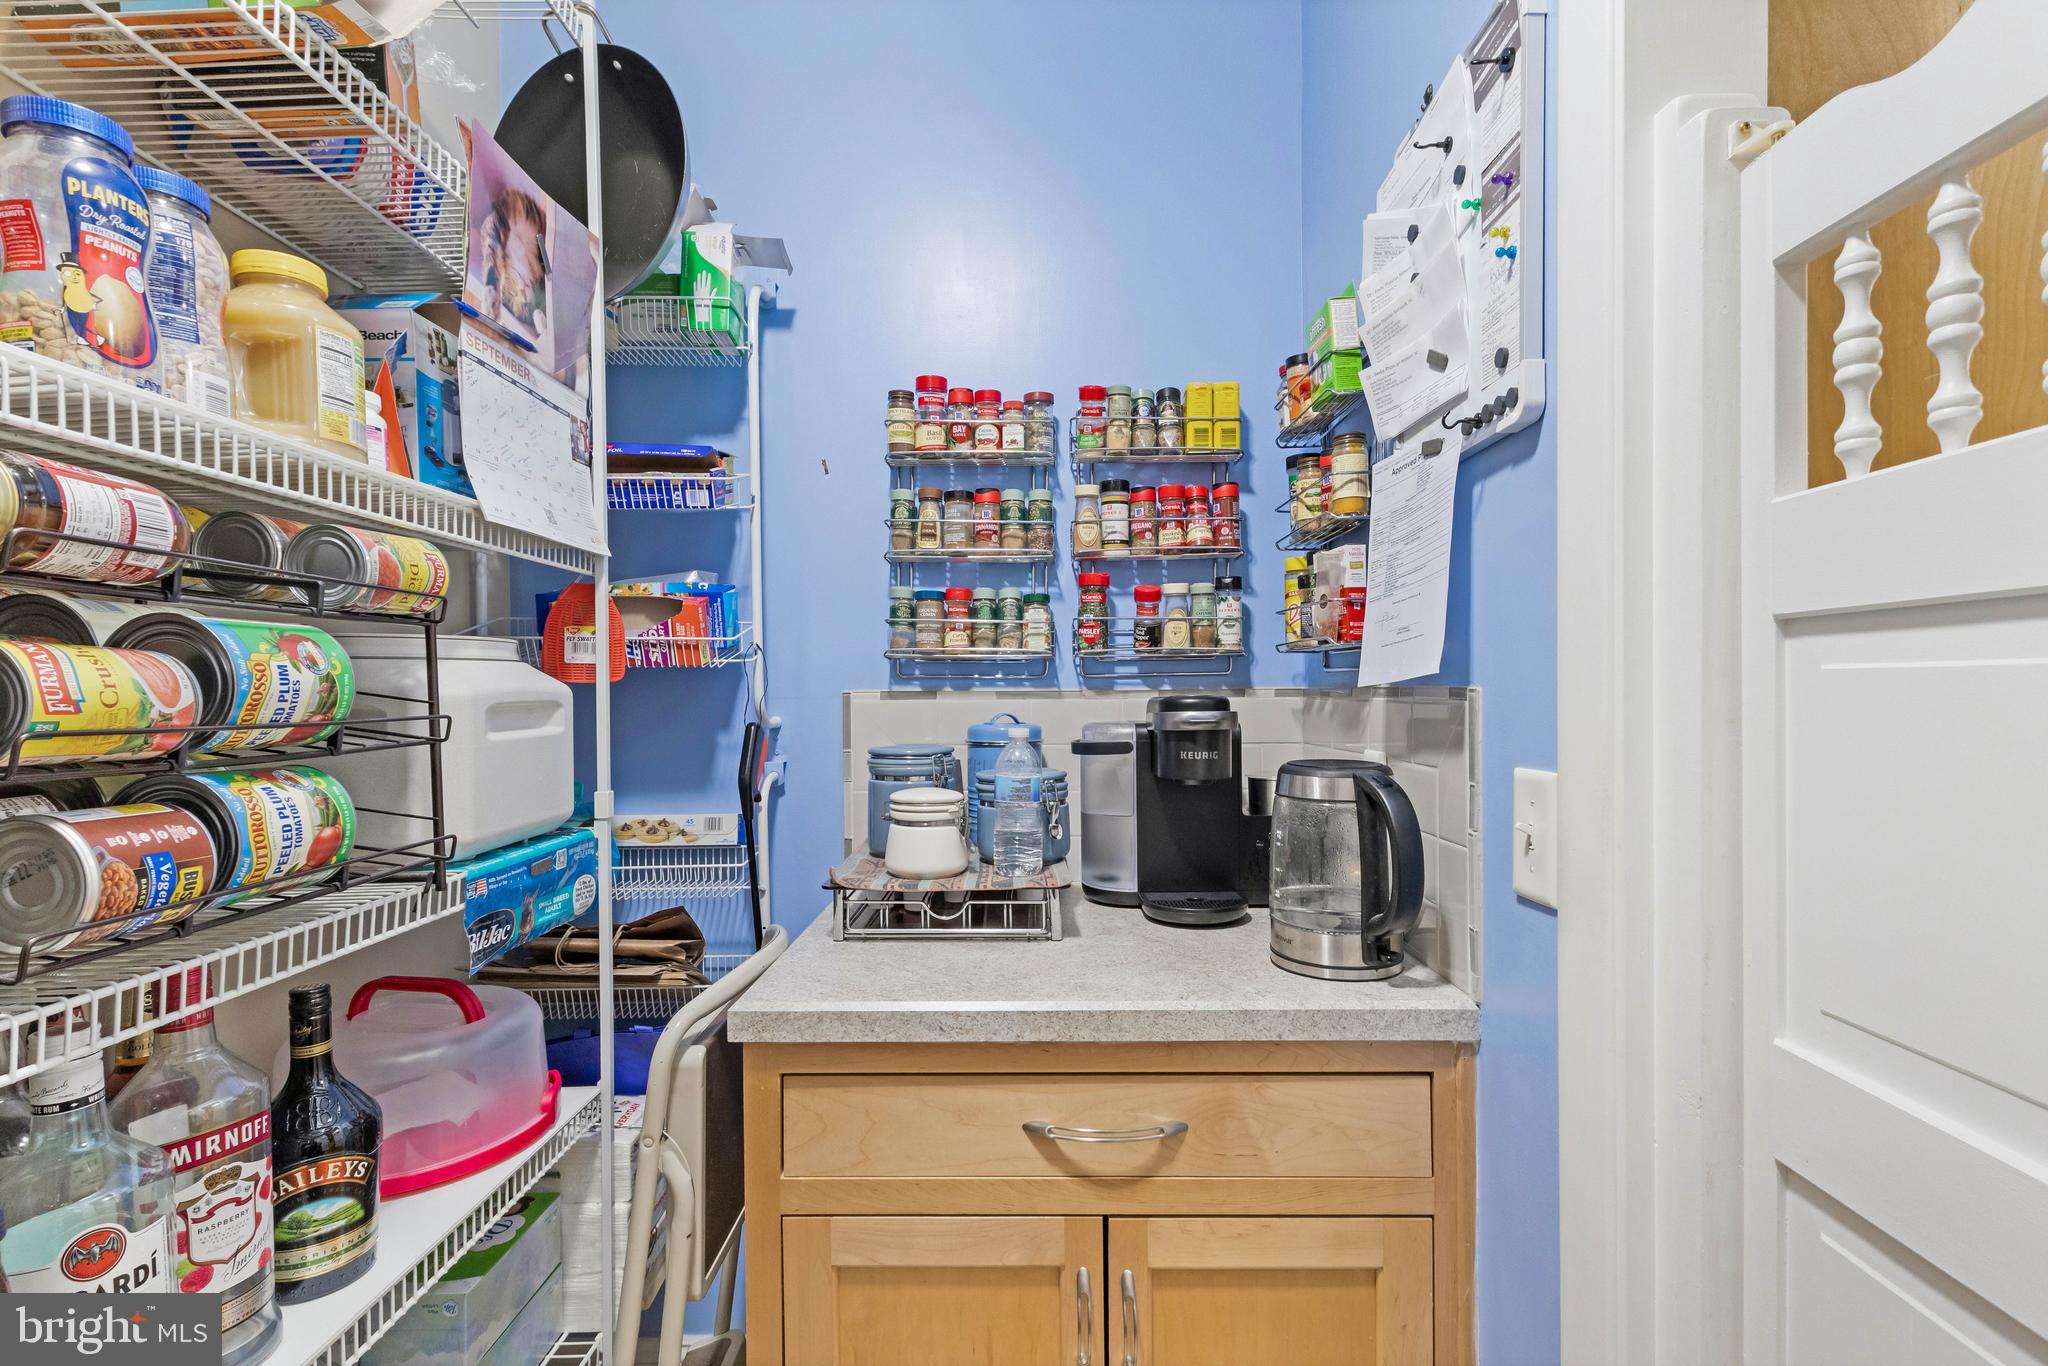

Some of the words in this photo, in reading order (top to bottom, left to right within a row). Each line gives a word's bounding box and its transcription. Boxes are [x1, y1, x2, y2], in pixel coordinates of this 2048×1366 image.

[66, 176, 151, 227] PLANTERS
[79, 204, 110, 228] Dry
[108, 213, 147, 242] Roasted
[84, 234, 139, 263] PEANUTS
[174, 236, 193, 250] 170
[465, 331, 531, 383] SEPTEMBER
[926, 429, 943, 437] Basil
[952, 424, 967, 433] BAY
[1391, 456, 1418, 477] Approved
[975, 524, 999, 532] CINNAMON
[399, 563, 421, 604] Dicd
[1078, 627, 1101, 635] PARSLEY
[276, 664, 291, 703] PLUM
[1180, 751, 1219, 760] KEURIG
[260, 786, 291, 821] PLUM
[237, 787, 269, 883] TUTTOROSSO
[285, 795, 303, 850] TOMATOES
[272, 823, 293, 875] PEELED
[236, 857, 250, 884] Added
[137, 878, 147, 910] BAKED
[544, 902, 563, 915] ADULT
[43, 1104, 60, 1115] RUM
[614, 1103, 641, 1129] VERYDAY
[197, 1207, 250, 1235] RASPBERRY
[275, 1257, 291, 1265] HE
[300, 1230, 370, 1262] ORIGINAL
